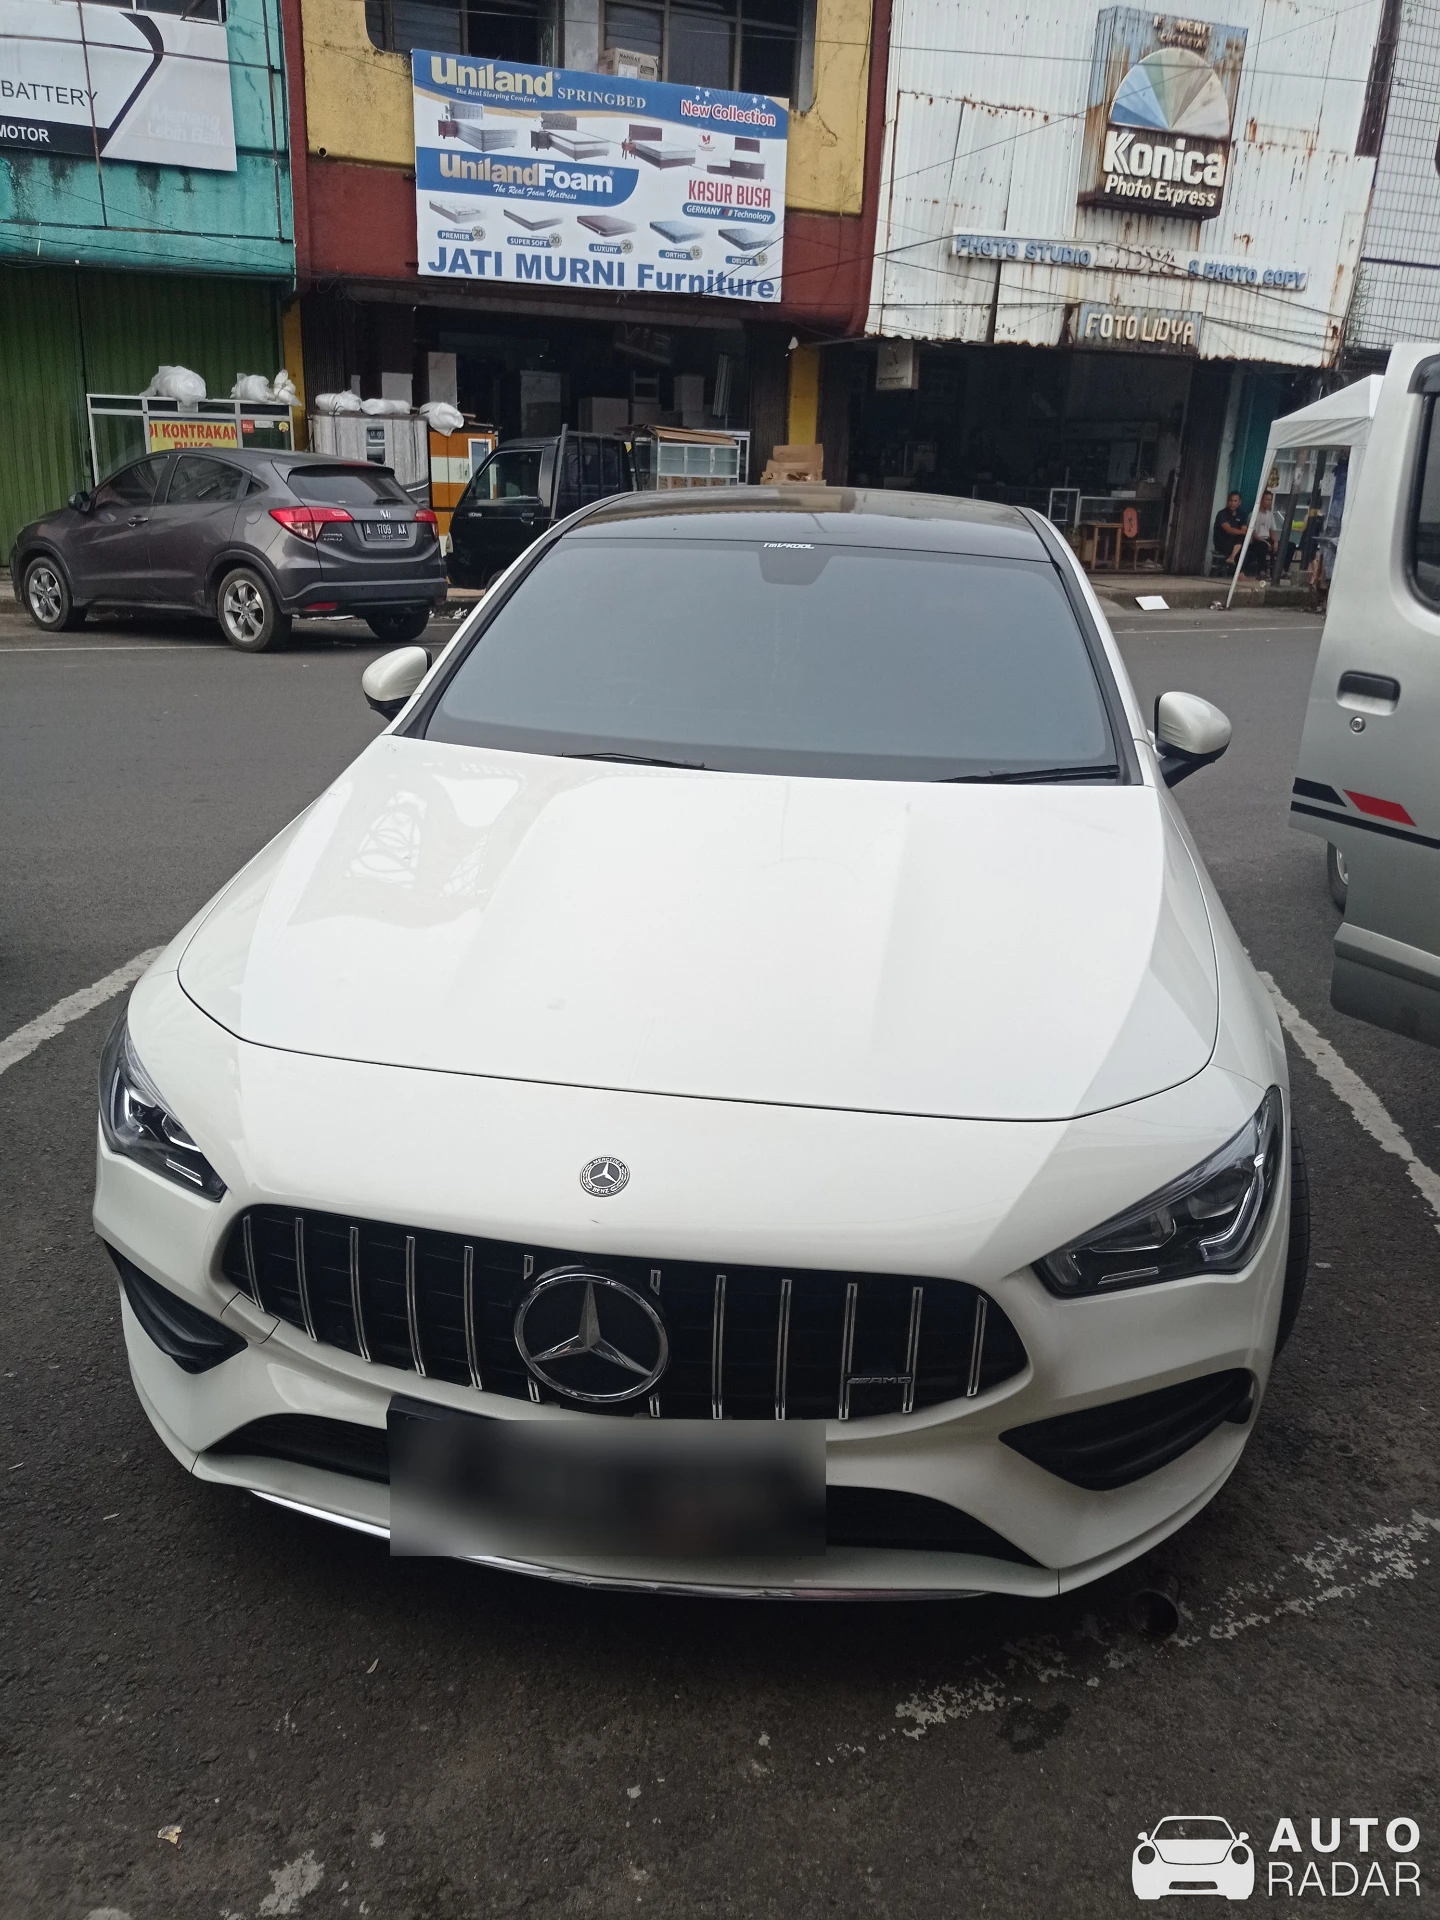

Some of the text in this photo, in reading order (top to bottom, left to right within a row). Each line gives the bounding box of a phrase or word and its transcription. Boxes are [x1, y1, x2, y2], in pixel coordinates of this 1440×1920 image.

[431, 56, 553, 97] Uniland
[1, 80, 98, 107] BATTERY
[468, 88, 482, 97] Real
[482, 91, 510, 101] Sleeping
[557, 87, 646, 109] SPRINGBED
[681, 100, 776, 126] New Collection
[1103, 131, 1225, 188] Konica
[439, 153, 613, 193] UnilandFoam
[493, 184, 577, 201] The Real Foam Mattress
[688, 180, 771, 208] KASUR BUSA
[1104, 174, 1217, 207] Photo Express
[686, 205, 771, 222] GERMANY Technology
[441, 231, 470, 241] PREMIER
[510, 238, 530, 246] SUPER
[531, 240, 548, 248] SOFT
[593, 245, 618, 253] LUXURY
[665, 251, 687, 260] ORTHO
[428, 247, 775, 299] JATI MURNI Furniture
[956, 235, 1019, 258] PHOTO
[1025, 241, 1092, 267] STUDIO
[1202, 261, 1258, 284] PHOTO
[1262, 269, 1306, 289] COPY
[1085, 313, 1195, 345] FOTO LIDYA
[162, 424, 237, 440] KONTRAKAN
[366, 523, 407, 535] A 1709 AX
